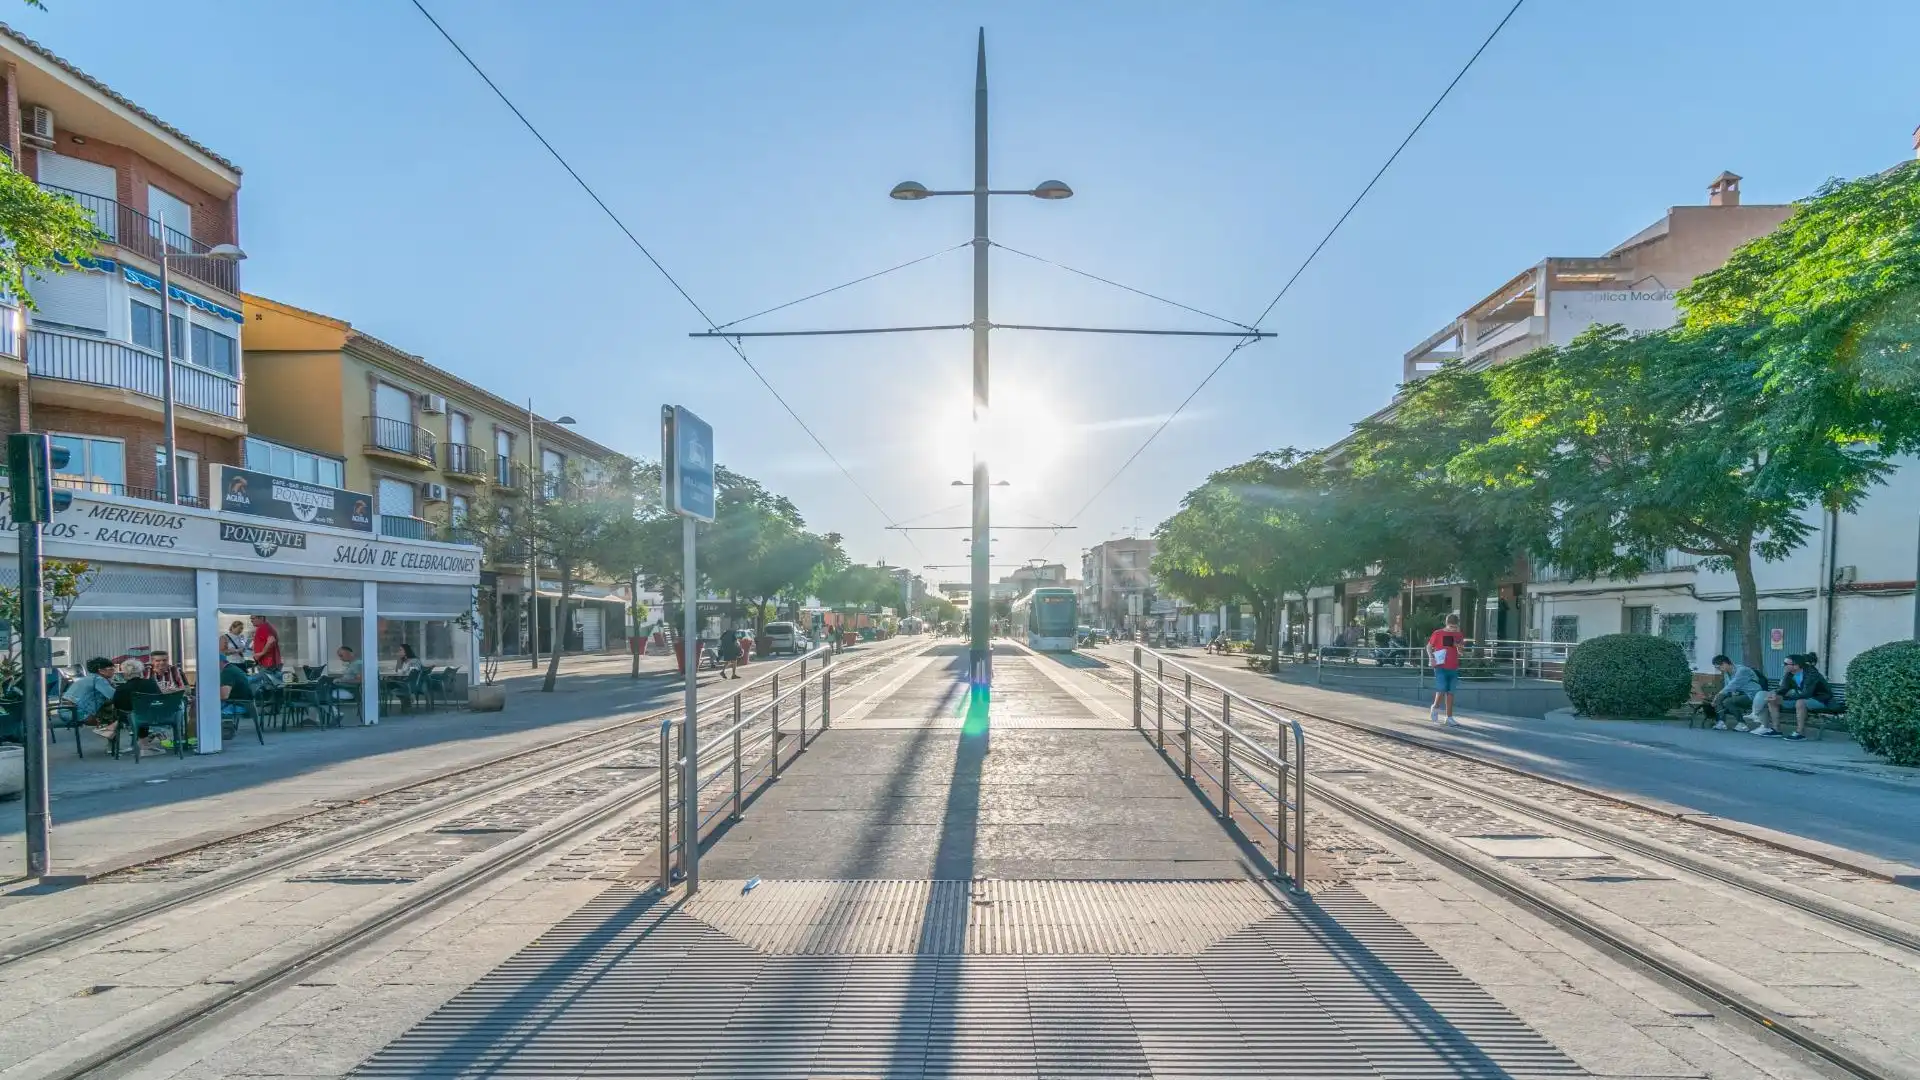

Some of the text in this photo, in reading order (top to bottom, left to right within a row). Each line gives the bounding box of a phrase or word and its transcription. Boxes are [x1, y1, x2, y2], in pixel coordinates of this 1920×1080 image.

[274, 486, 333, 508] PONIENTE
[88, 504, 186, 530] MERIENDAS
[95, 527, 178, 548] RACIONES
[224, 525, 303, 548] PONIENTE
[333, 544, 475, 572] SALÓN DE CELEBRACIONES
